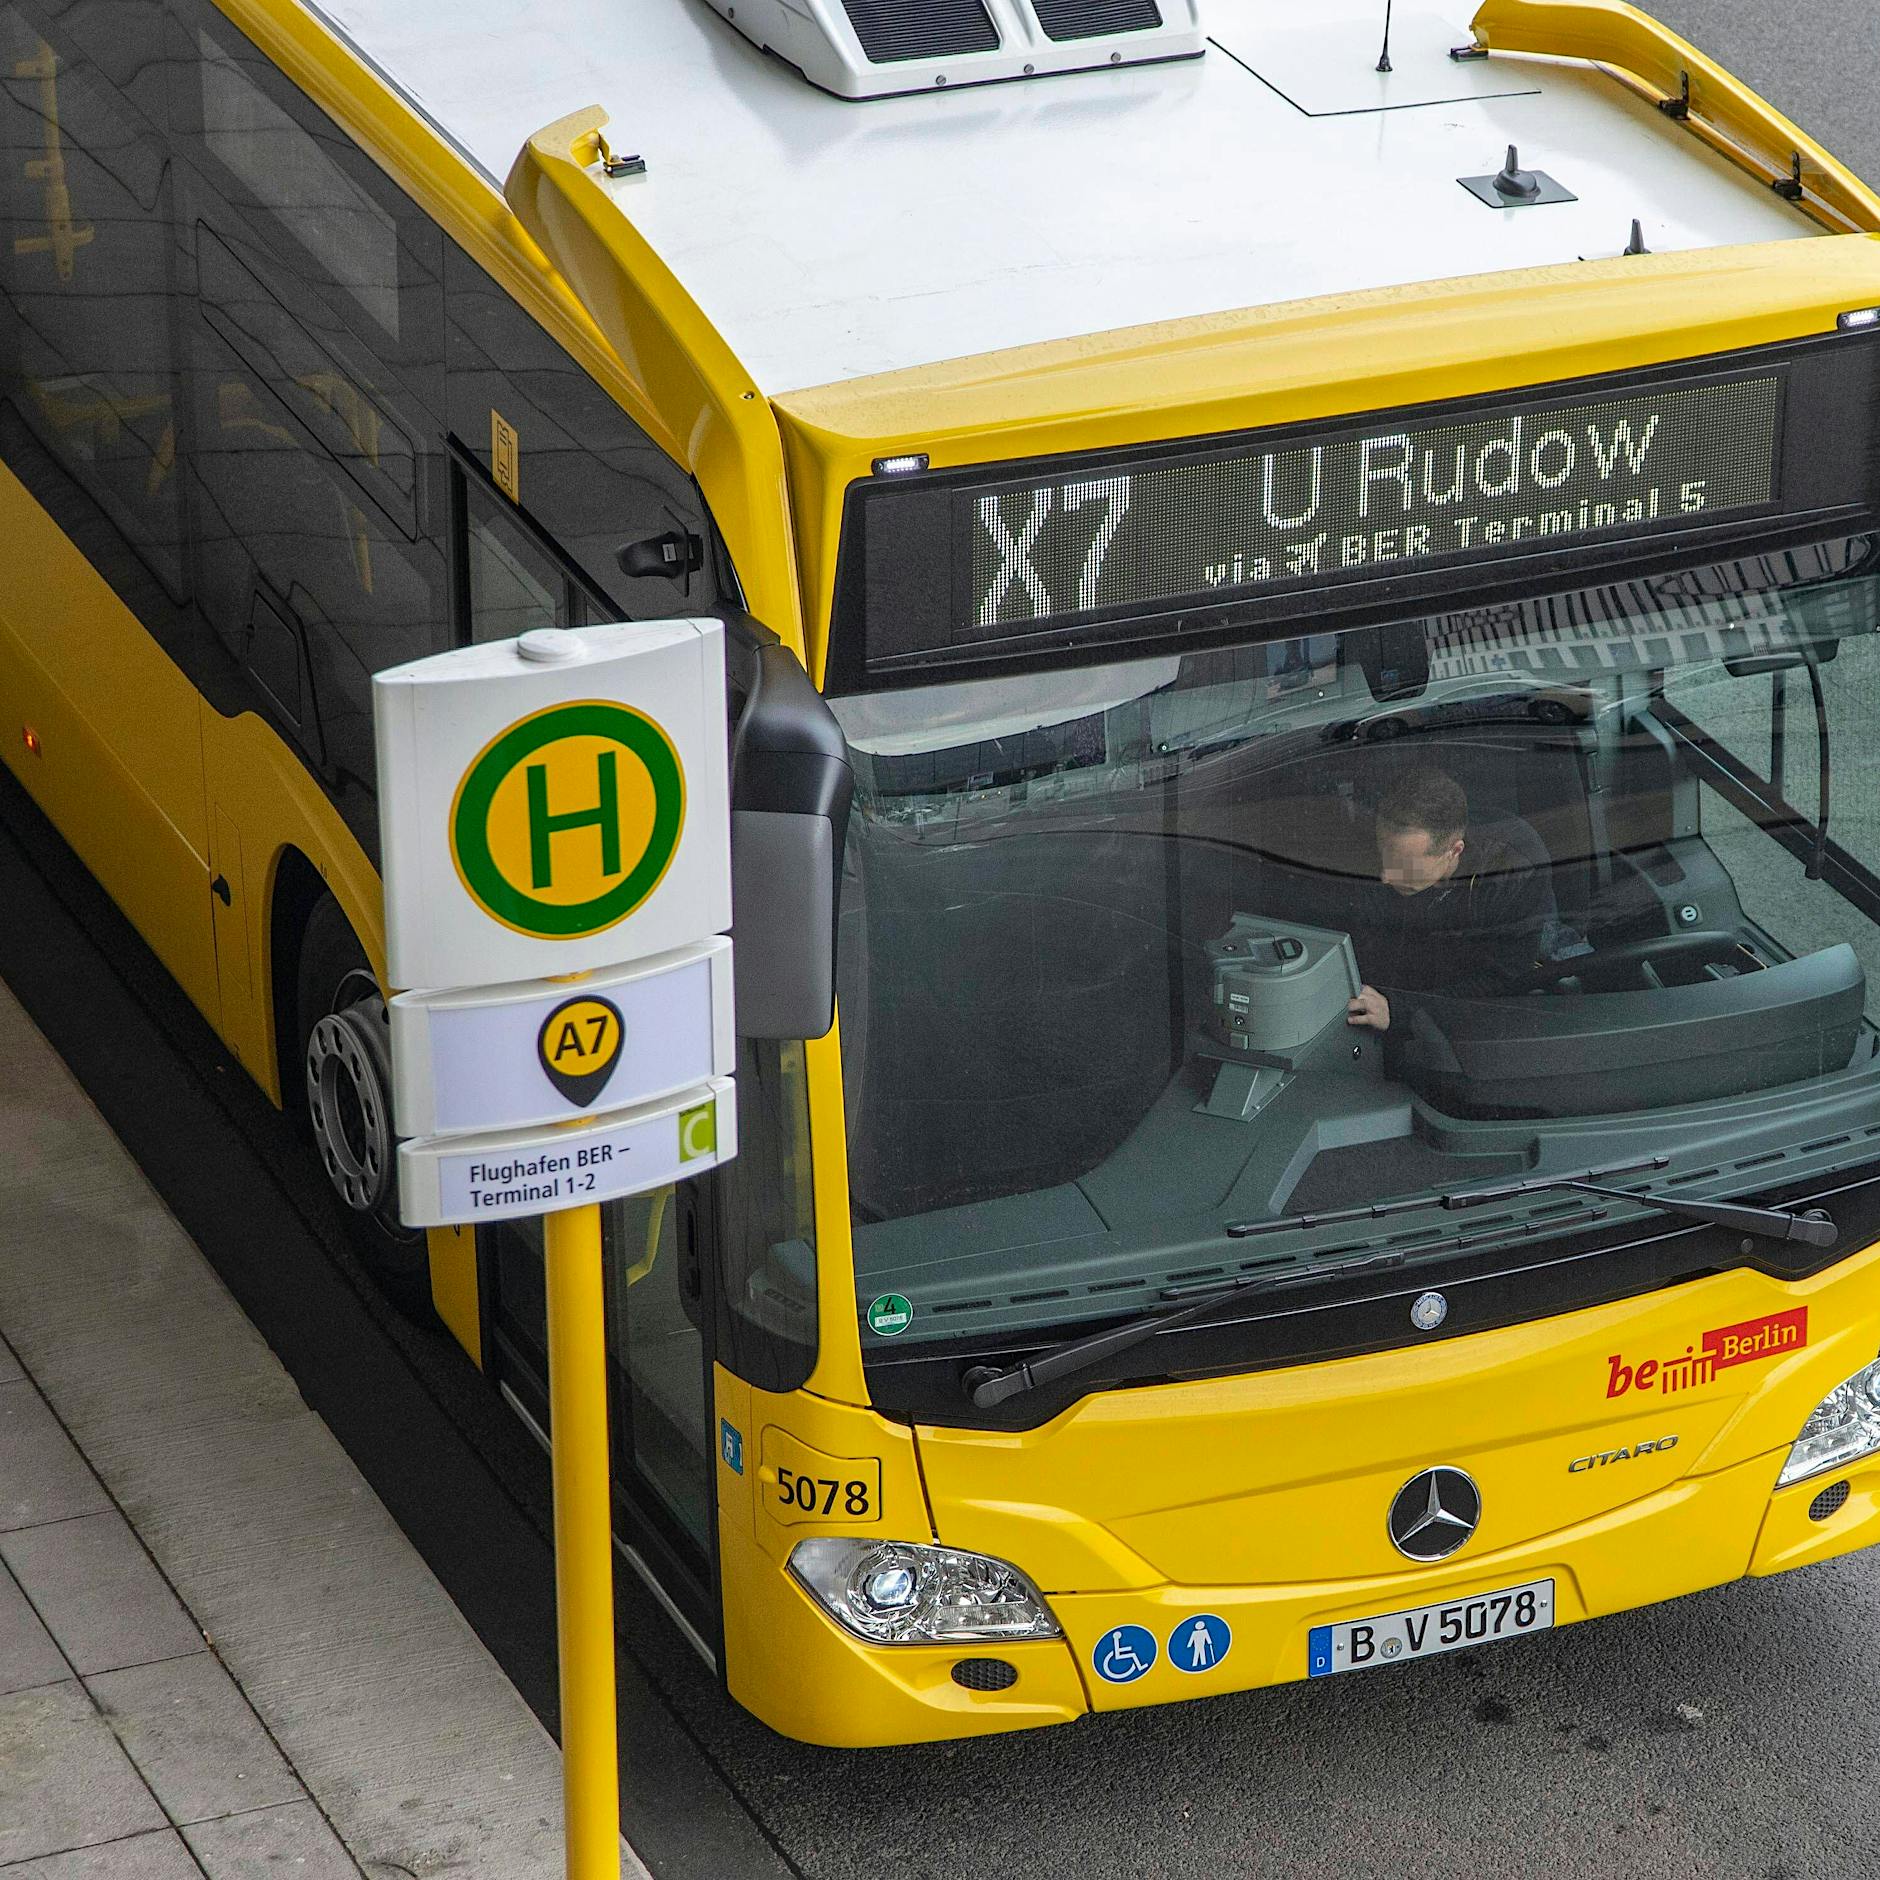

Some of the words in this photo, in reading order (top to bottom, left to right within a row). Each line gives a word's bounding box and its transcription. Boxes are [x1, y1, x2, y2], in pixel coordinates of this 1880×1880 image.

[1262, 446, 1323, 530] U
[1359, 414, 1660, 518] Rudow
[981, 475, 1130, 627] X7
[1205, 553, 1271, 587] via
[1342, 524, 1431, 567] BER
[1454, 487, 1659, 548] Terminal
[1681, 481, 1706, 512] 5
[527, 750, 622, 889] H
[554, 1015, 608, 1061] A7
[470, 1154, 570, 1184] Flughafen
[577, 1144, 613, 1167] BER
[470, 1178, 559, 1207] Terminal
[566, 1173, 596, 1194] 1-2
[883, 1296, 897, 1315] 4
[1606, 1354, 1659, 1399] be
[1722, 1323, 1798, 1360] Berlin
[1568, 1434, 1679, 1473] CITARO
[778, 1467, 869, 1516] 5078
[1351, 1626, 1375, 1664] B
[1405, 1614, 1429, 1651] V
[1440, 1590, 1536, 1644] 5078
[1316, 1656, 1326, 1668] D
